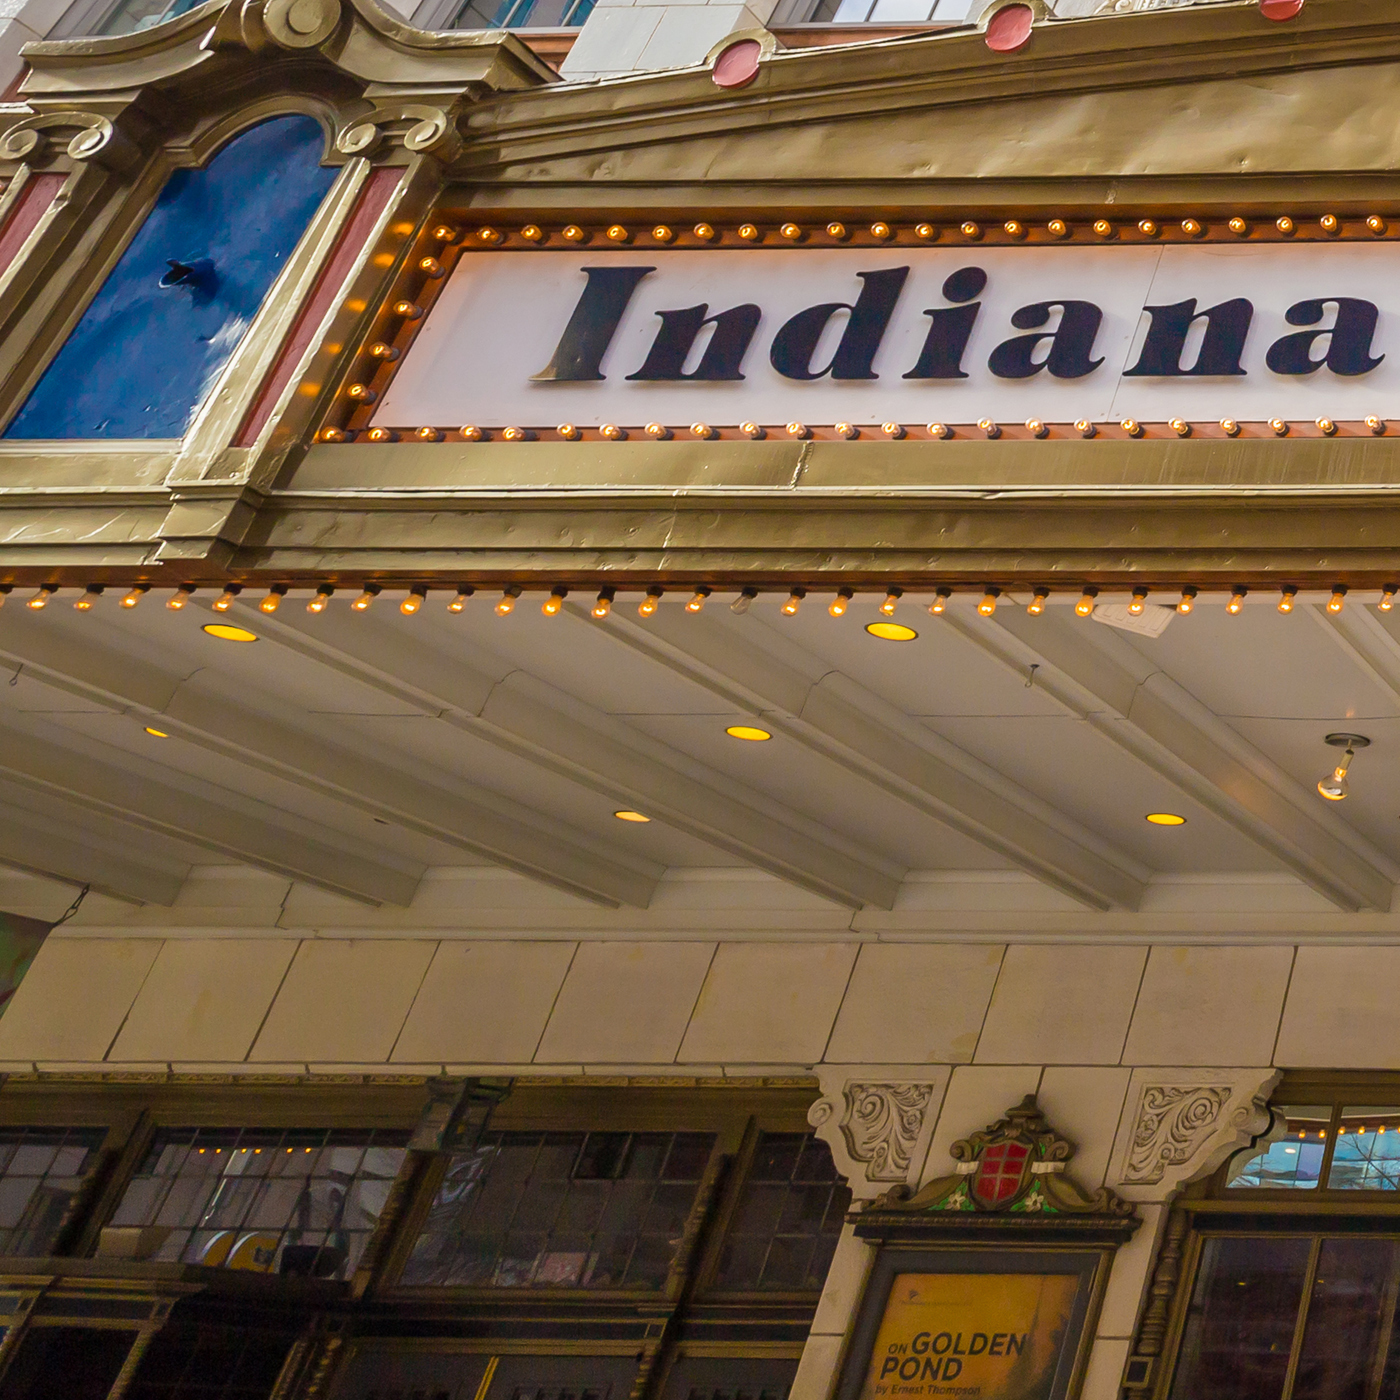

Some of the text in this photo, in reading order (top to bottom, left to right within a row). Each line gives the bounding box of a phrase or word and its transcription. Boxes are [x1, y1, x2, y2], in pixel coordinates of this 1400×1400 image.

[528, 265, 1387, 382] Indiana
[888, 1331, 1028, 1356] ON GOLDEN
[879, 1356, 963, 1381] POND
[874, 1383, 981, 1396] by Ernest Thompson
